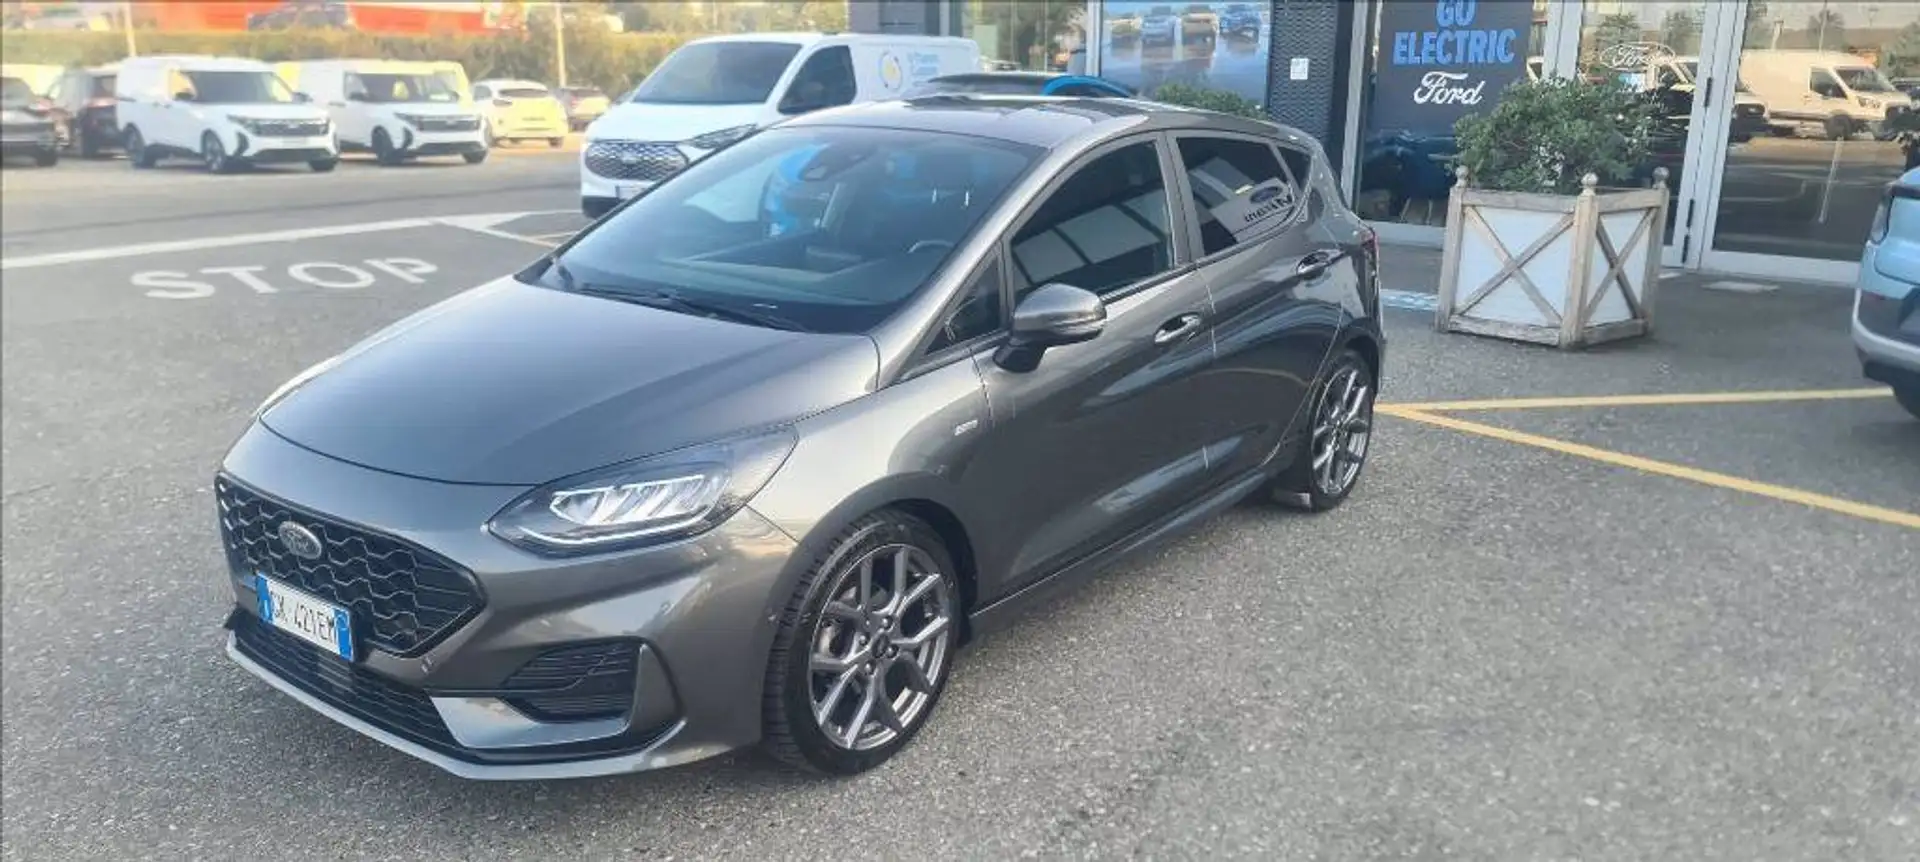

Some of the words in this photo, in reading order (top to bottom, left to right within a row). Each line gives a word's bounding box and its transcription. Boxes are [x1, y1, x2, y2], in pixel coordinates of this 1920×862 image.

[1437, 0, 1476, 27] GO
[1393, 29, 1517, 66] ELECTRIC
[1413, 71, 1486, 105] Ford
[131, 257, 437, 299] STOP
